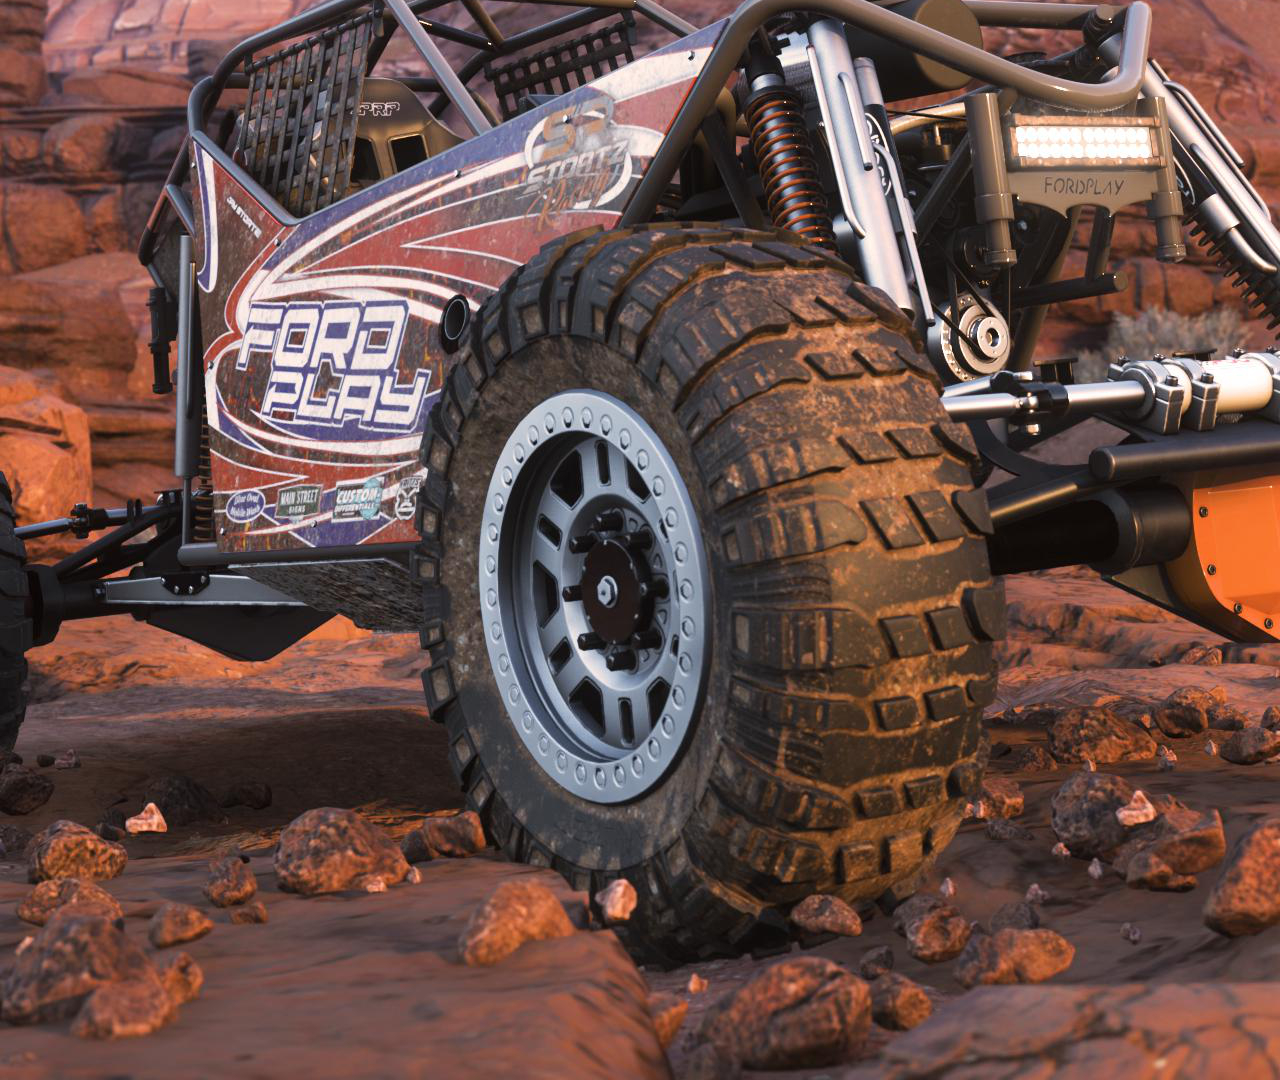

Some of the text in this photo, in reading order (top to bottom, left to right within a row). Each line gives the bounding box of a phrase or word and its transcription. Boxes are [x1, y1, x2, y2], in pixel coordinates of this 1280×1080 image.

[357, 101, 401, 117] PRP
[1043, 176, 1125, 195] FORDPLAY
[237, 301, 410, 371] FORD
[261, 368, 431, 431] PLAY
[280, 489, 318, 505] MAIN STREET
[336, 488, 378, 503] CUSTOM
